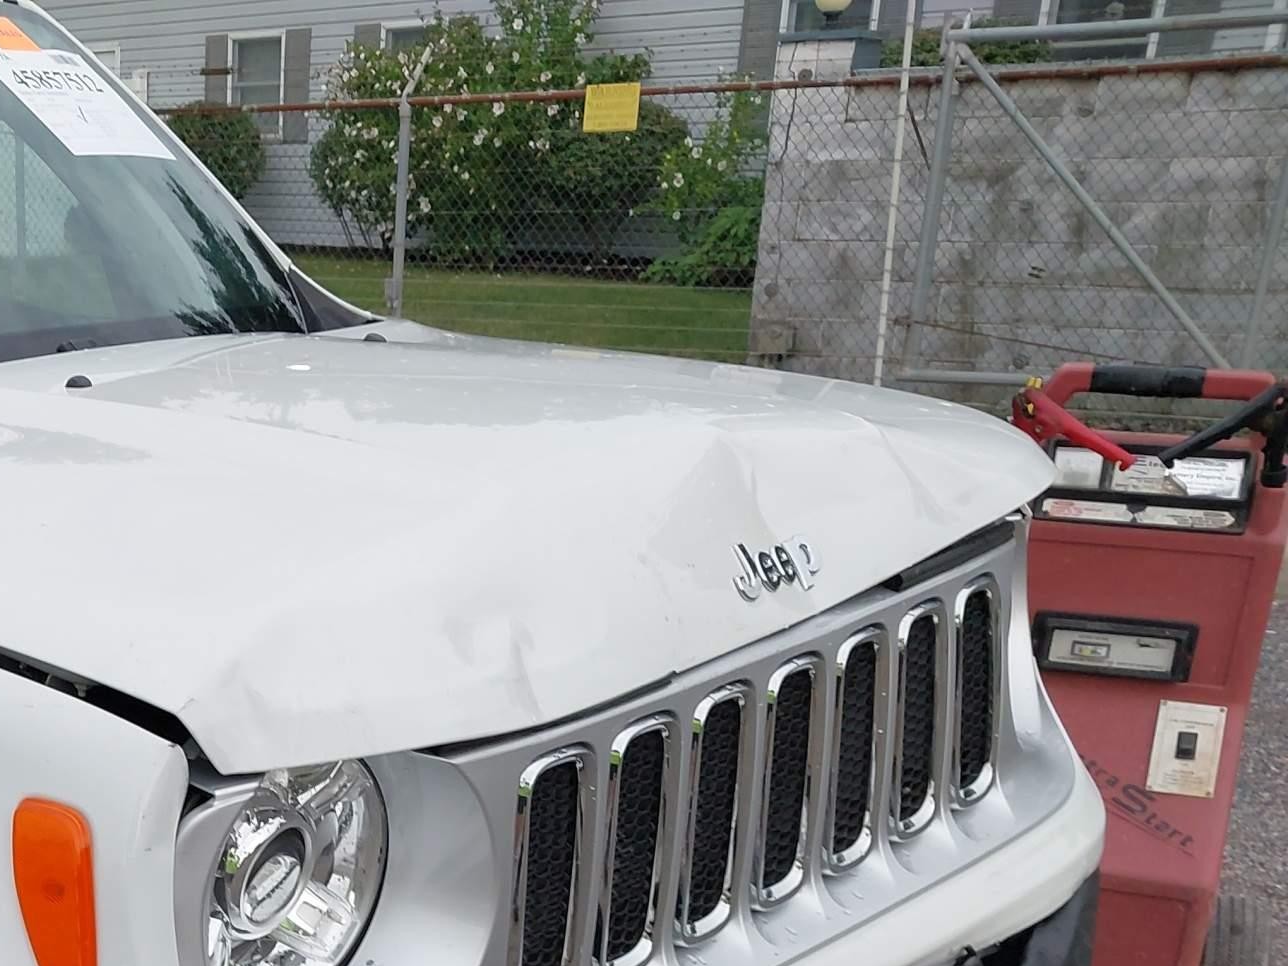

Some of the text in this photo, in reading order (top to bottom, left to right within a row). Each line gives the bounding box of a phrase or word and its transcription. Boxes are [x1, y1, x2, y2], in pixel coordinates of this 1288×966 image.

[11, 69, 105, 93] 45857512
[731, 541, 820, 602] Jeep
[1079, 753, 1195, 848] traStart
